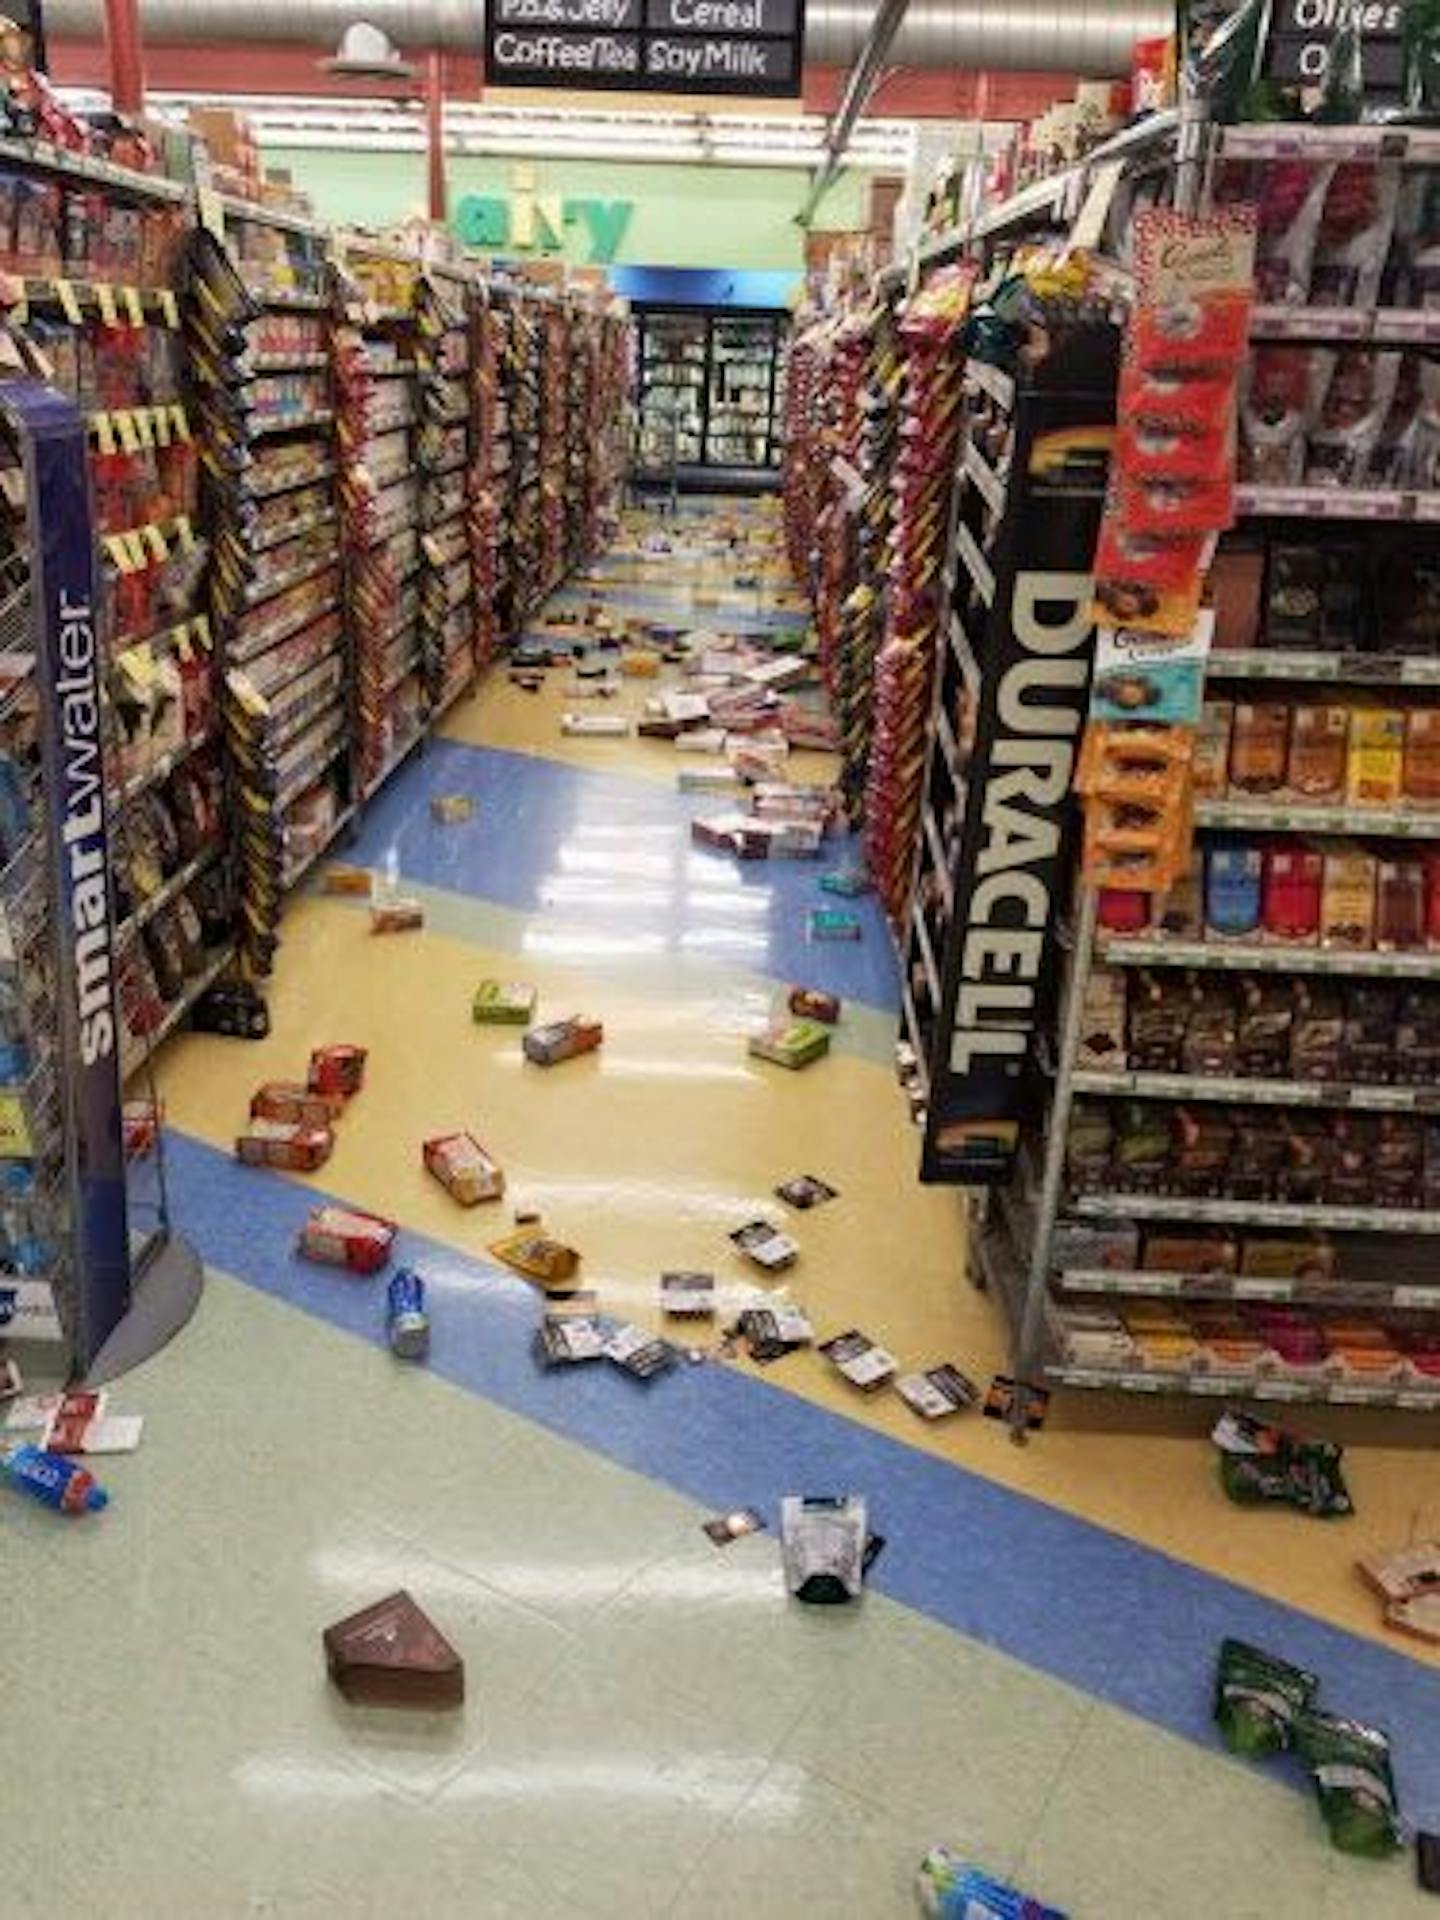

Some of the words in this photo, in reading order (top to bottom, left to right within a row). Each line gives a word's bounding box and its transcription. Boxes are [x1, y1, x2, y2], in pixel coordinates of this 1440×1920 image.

[669, 0, 762, 28] Cereal
[56, 590, 113, 1066] smartwater
[949, 570, 1097, 1076] DURACELL
